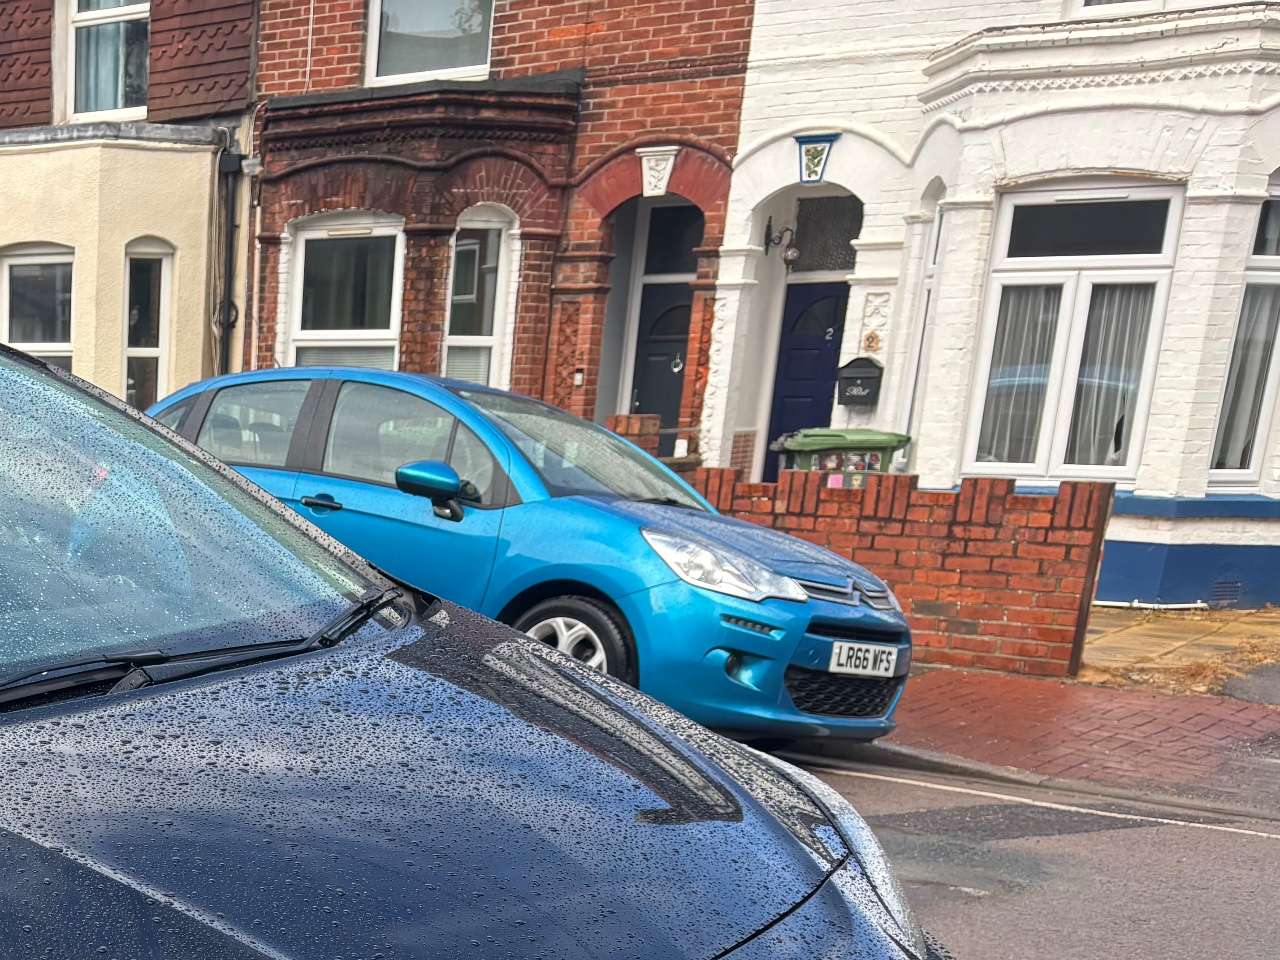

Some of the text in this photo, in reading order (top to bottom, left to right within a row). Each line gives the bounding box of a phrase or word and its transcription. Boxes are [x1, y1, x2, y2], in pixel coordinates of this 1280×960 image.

[825, 327, 834, 340] 2
[836, 644, 893, 672] LR66 WFS
